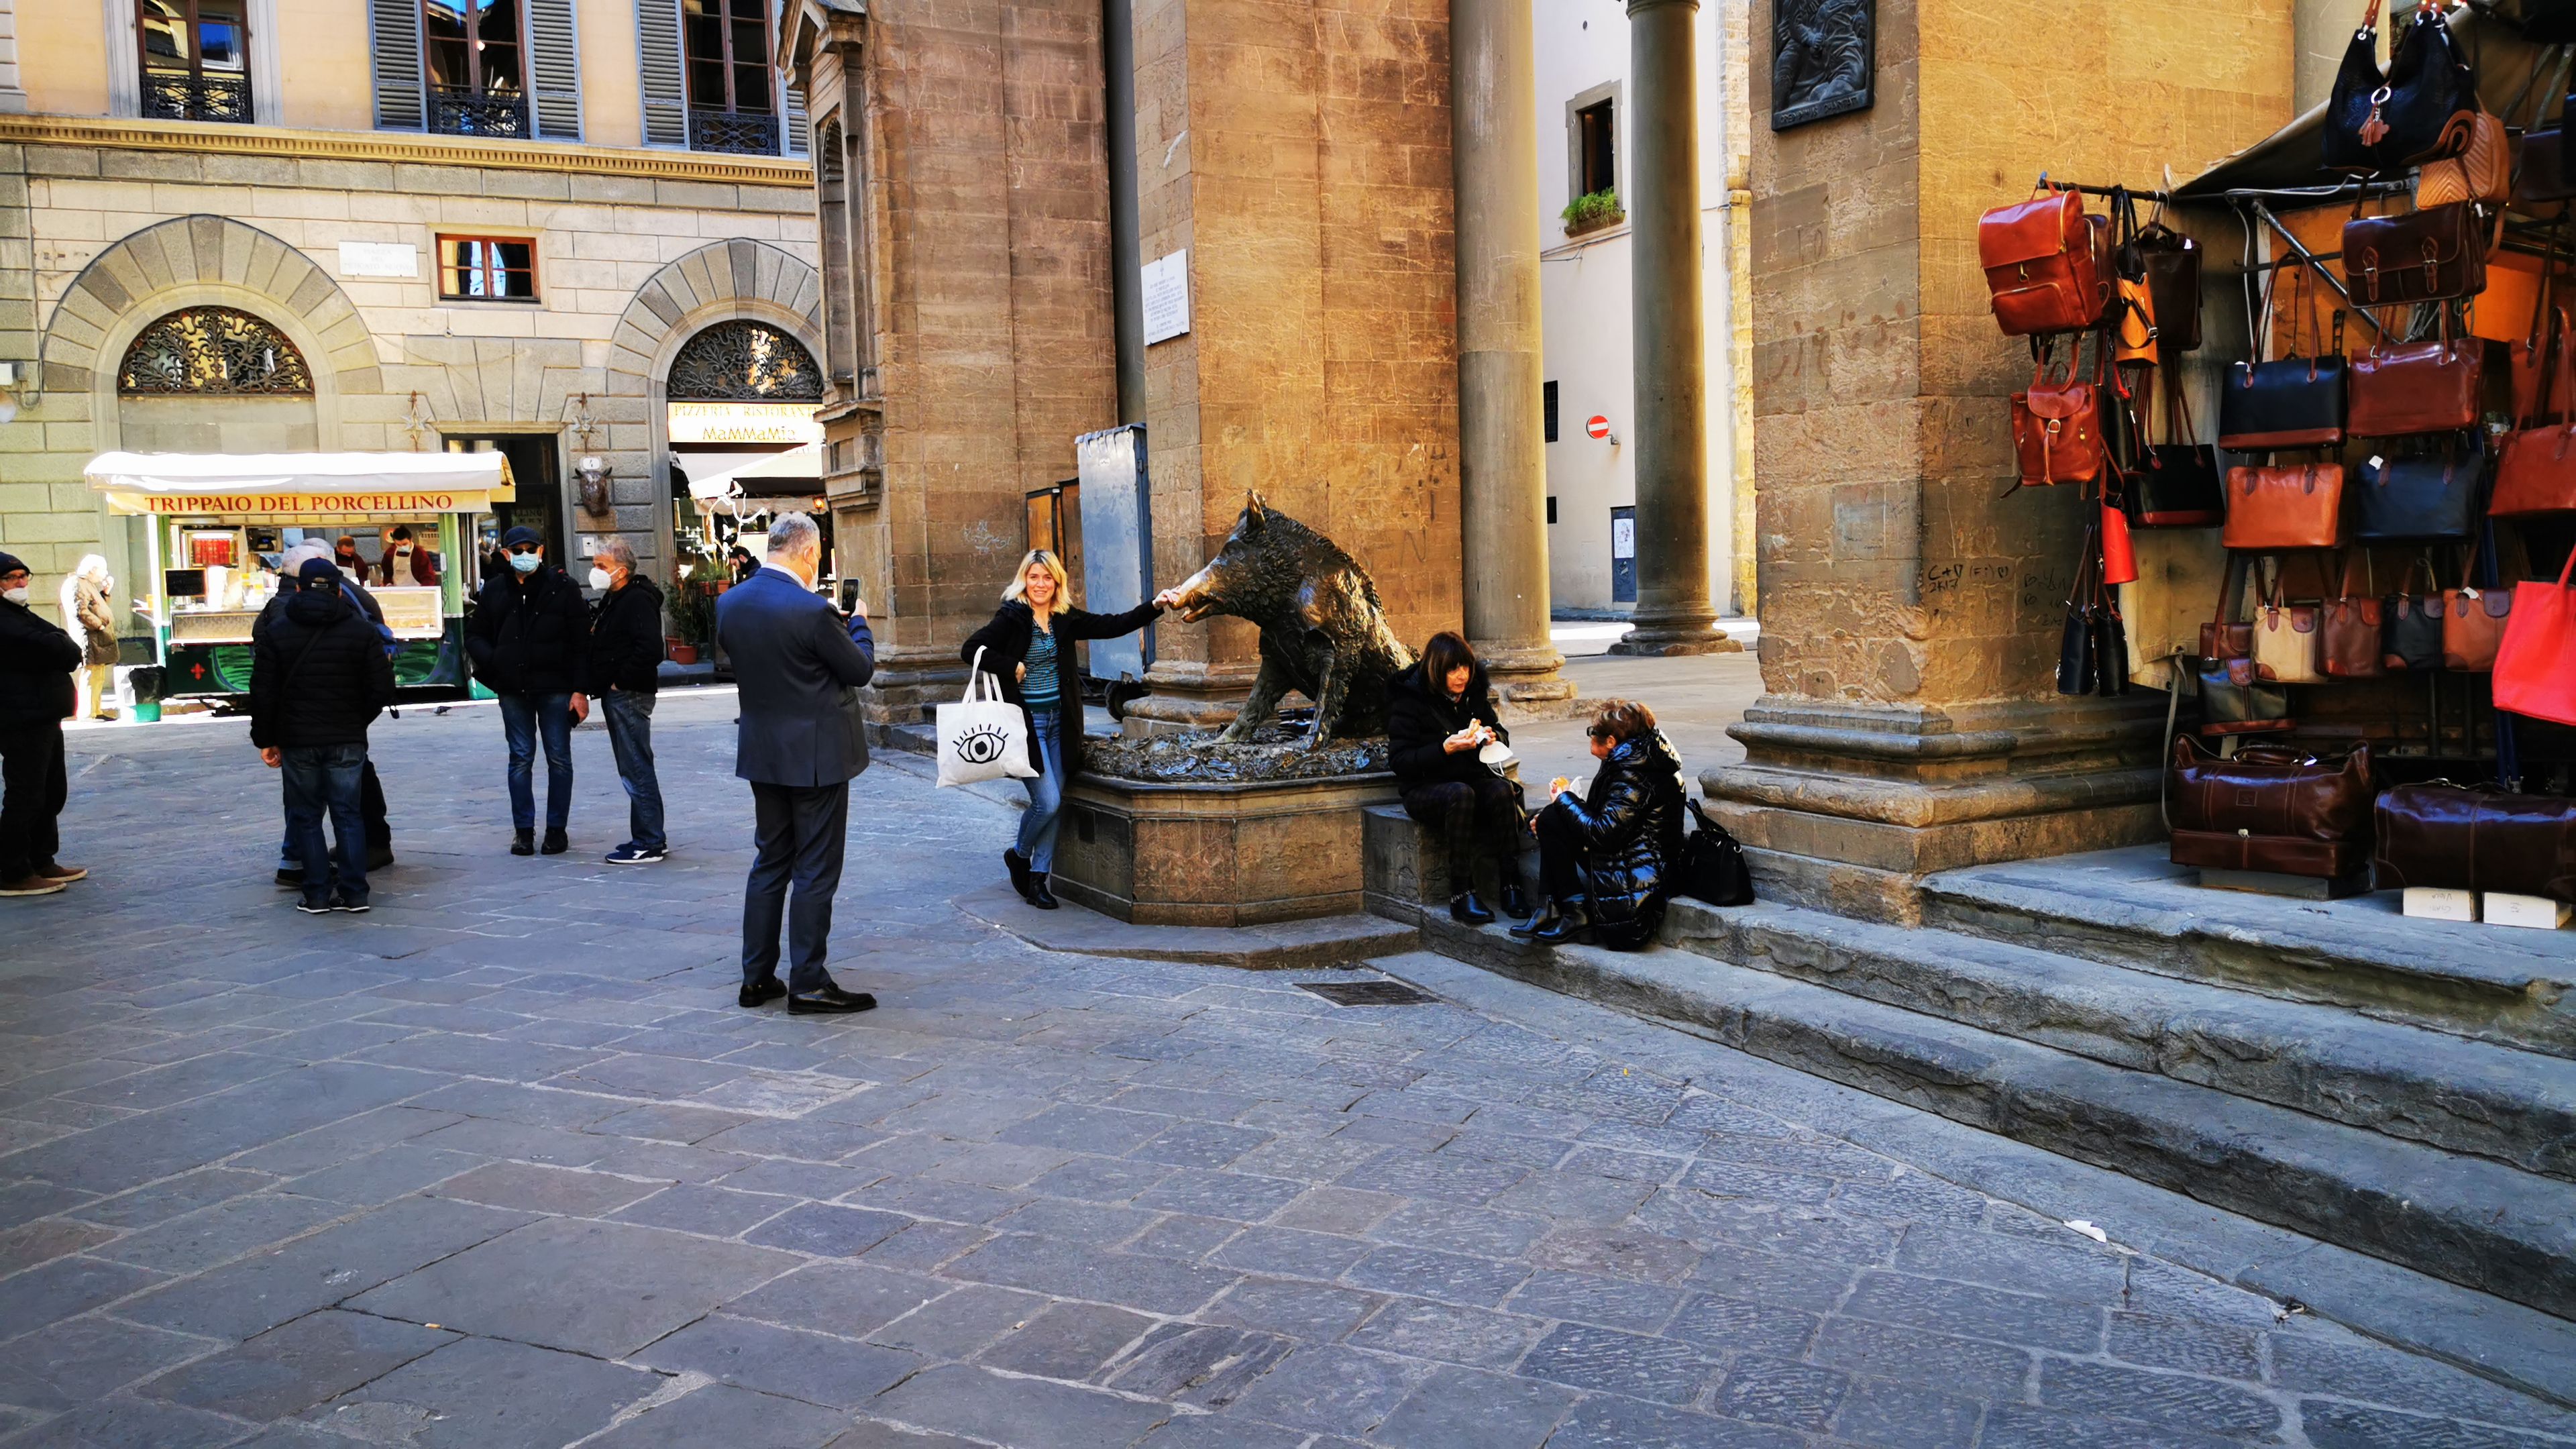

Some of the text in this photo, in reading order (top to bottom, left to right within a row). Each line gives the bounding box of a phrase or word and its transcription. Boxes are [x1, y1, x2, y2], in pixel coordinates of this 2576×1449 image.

[674, 405, 731, 417] PIZZERIA
[144, 494, 453, 512] TRIPPAIO DEL PORCELLINO
